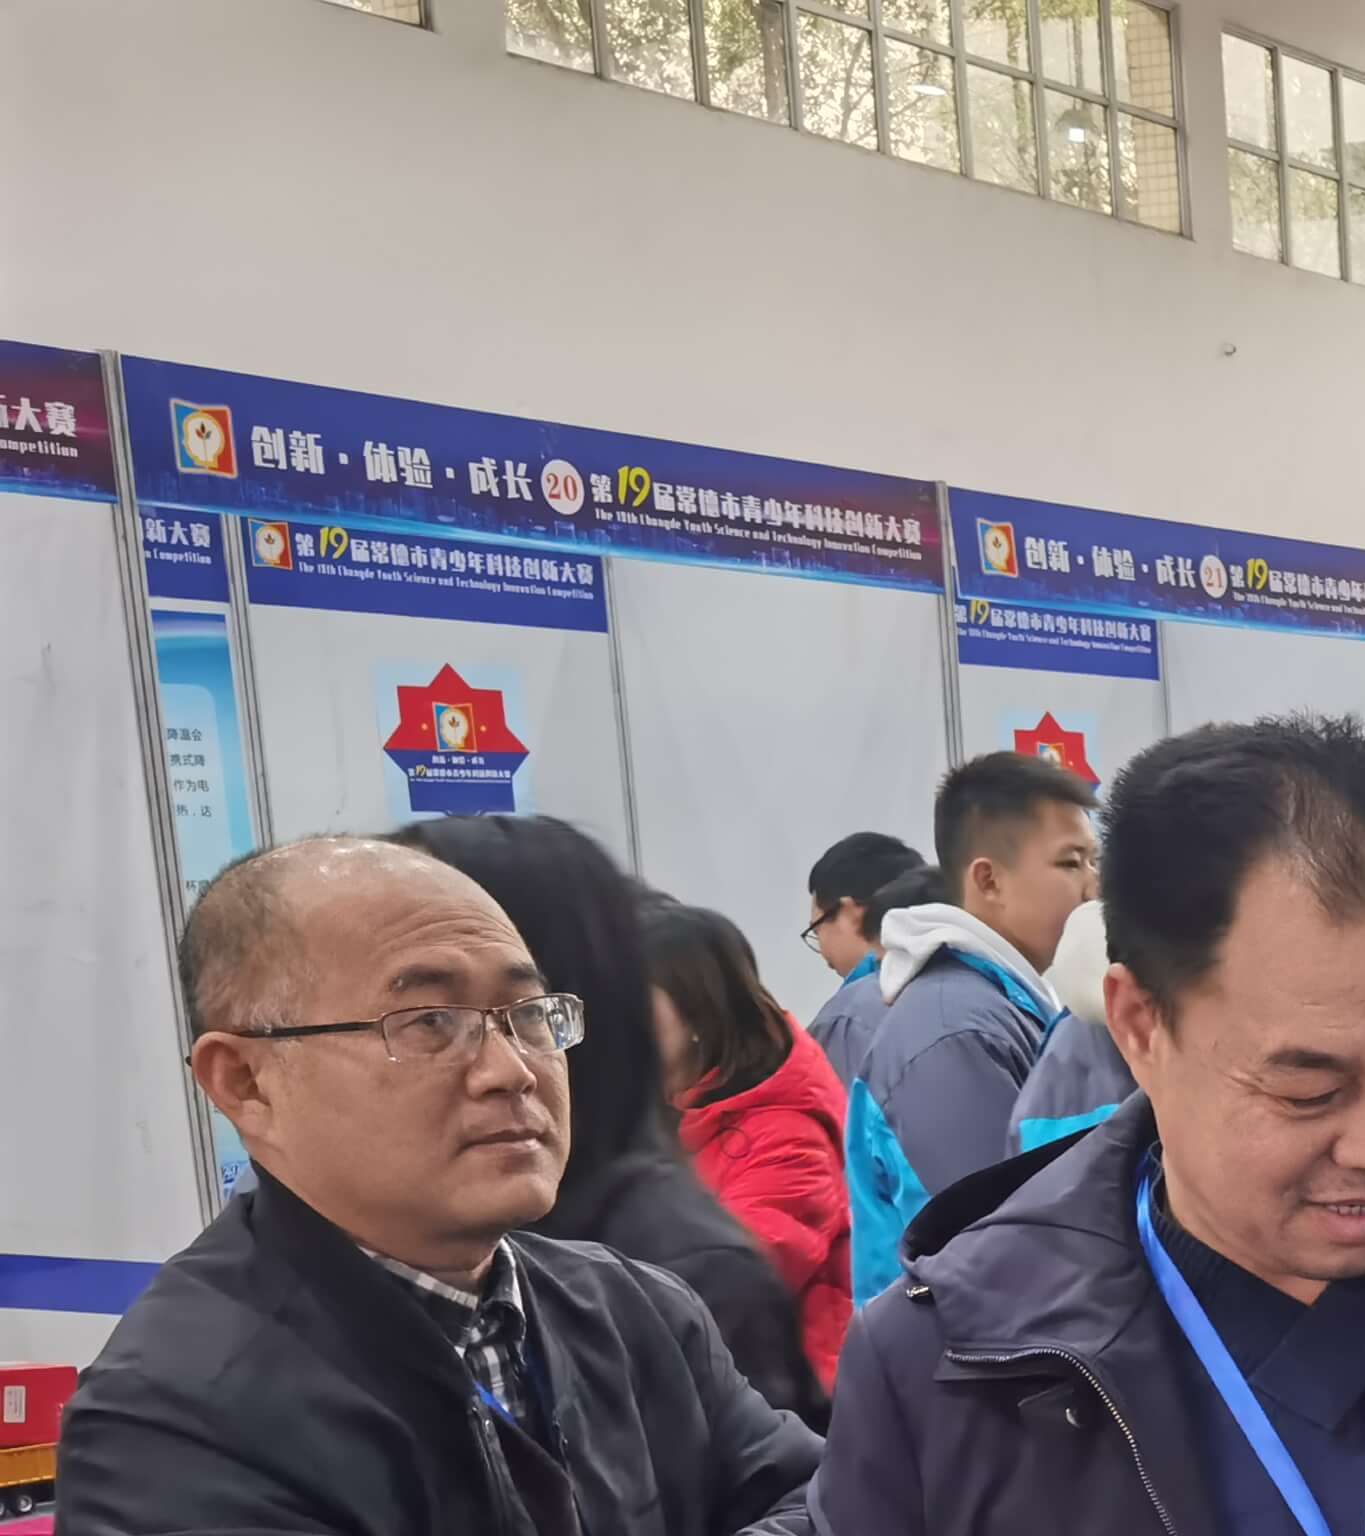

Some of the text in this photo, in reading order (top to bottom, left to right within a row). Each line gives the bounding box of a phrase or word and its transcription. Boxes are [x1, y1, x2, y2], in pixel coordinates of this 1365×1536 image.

[0, 438, 78, 458] ompetition
[546, 472, 578, 502] 20
[589, 465, 922, 546] 第19届常德市青少年科技创新大赛
[683, 520, 713, 534] Youth
[714, 523, 751, 539] Science
[751, 530, 770, 541] and
[772, 530, 822, 549] Technology
[872, 544, 923, 561] Competition
[153, 548, 212, 565] Competition
[1203, 563, 1225, 589] 21
